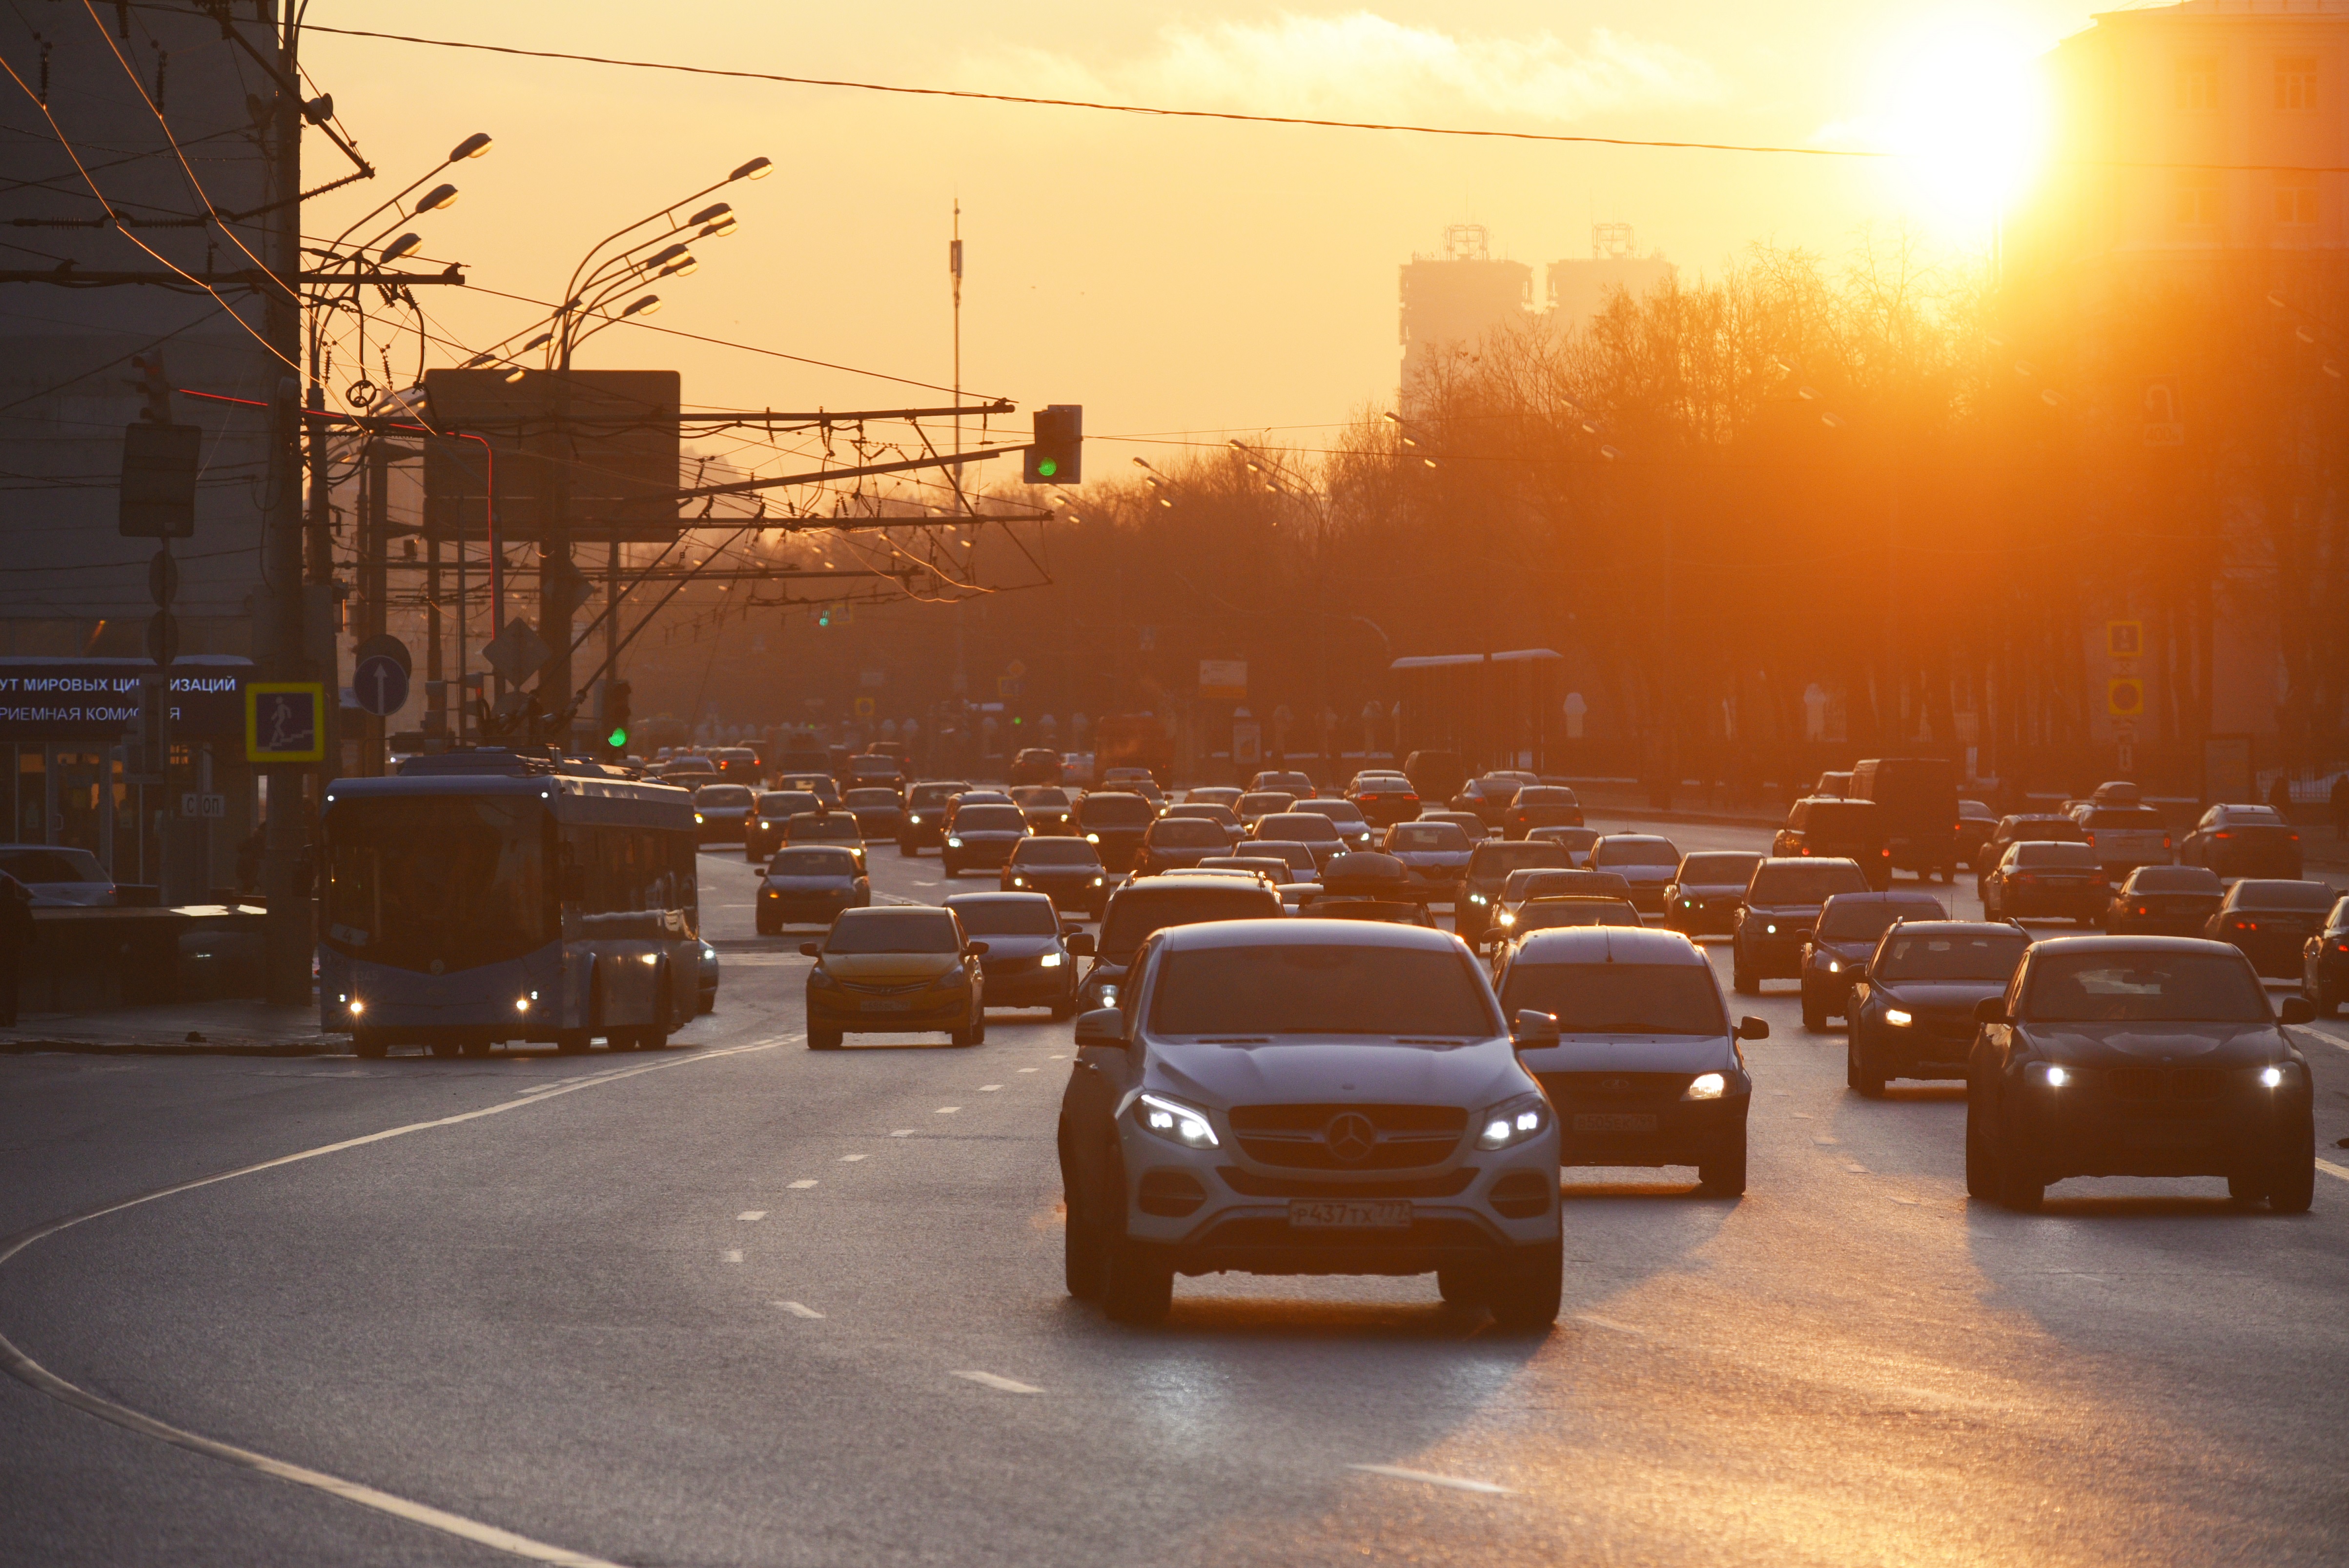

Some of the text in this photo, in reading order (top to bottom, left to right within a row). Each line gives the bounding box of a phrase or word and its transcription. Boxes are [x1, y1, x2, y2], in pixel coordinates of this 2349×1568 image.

[23, 678, 108, 691] МИРОВЫХ
[113, 675, 236, 693] ЦИИЗАЦИЙ
[1539, 873, 1614, 885] Яндекс Такси
[343, 928, 352, 943] 4
